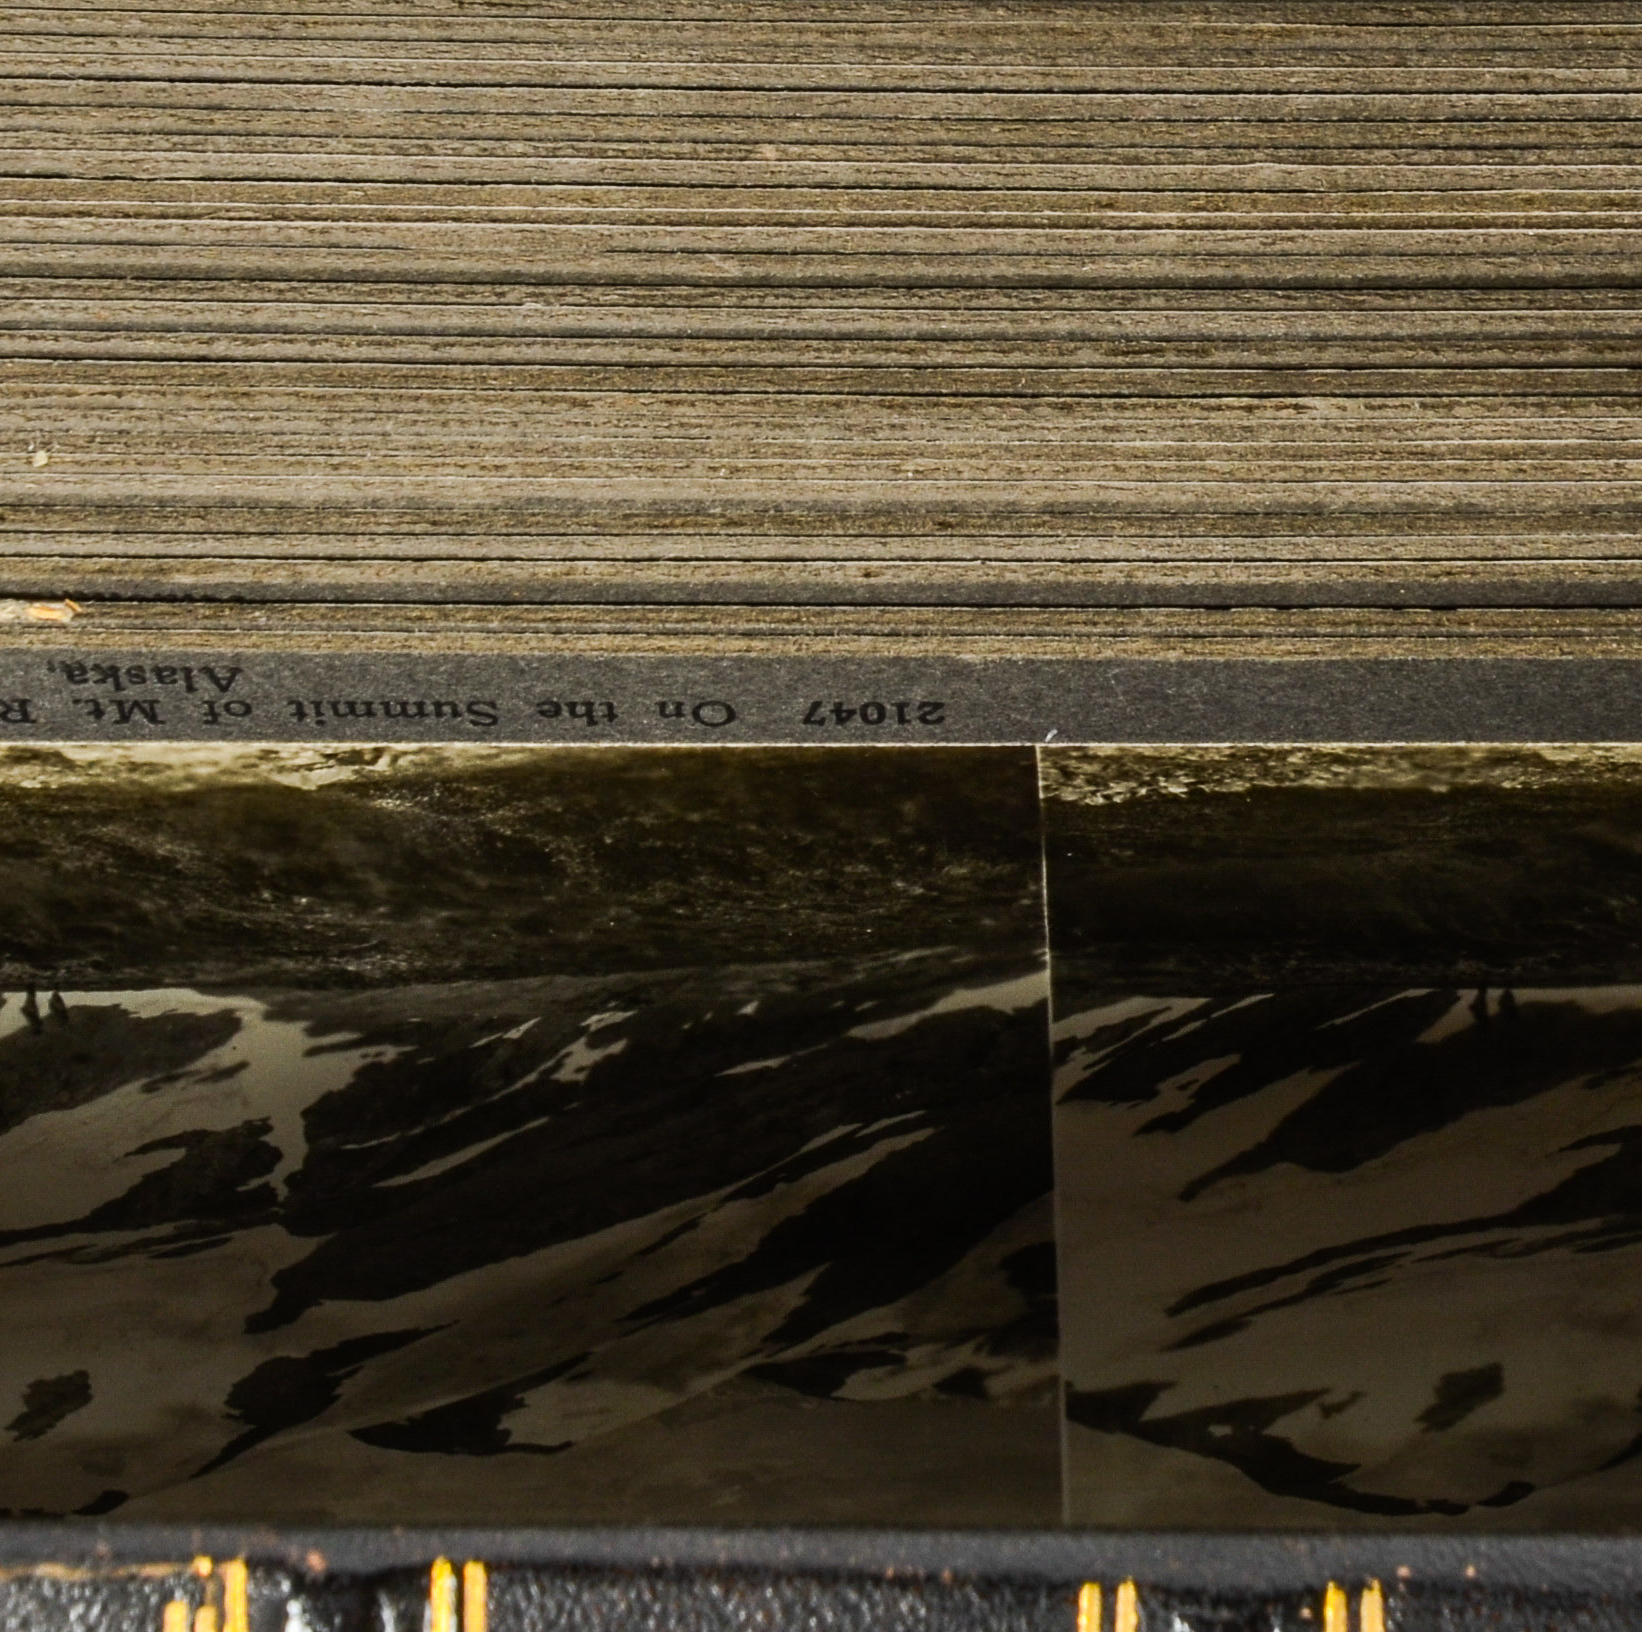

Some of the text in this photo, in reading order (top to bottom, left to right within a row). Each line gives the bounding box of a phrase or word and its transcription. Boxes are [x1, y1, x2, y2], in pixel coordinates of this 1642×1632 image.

[72, 698, 165, 725] Mt.
[202, 701, 254, 725] of
[287, 700, 500, 728] Summit
[536, 701, 619, 727] the
[657, 701, 737, 728] On
[802, 702, 946, 726] 21047
